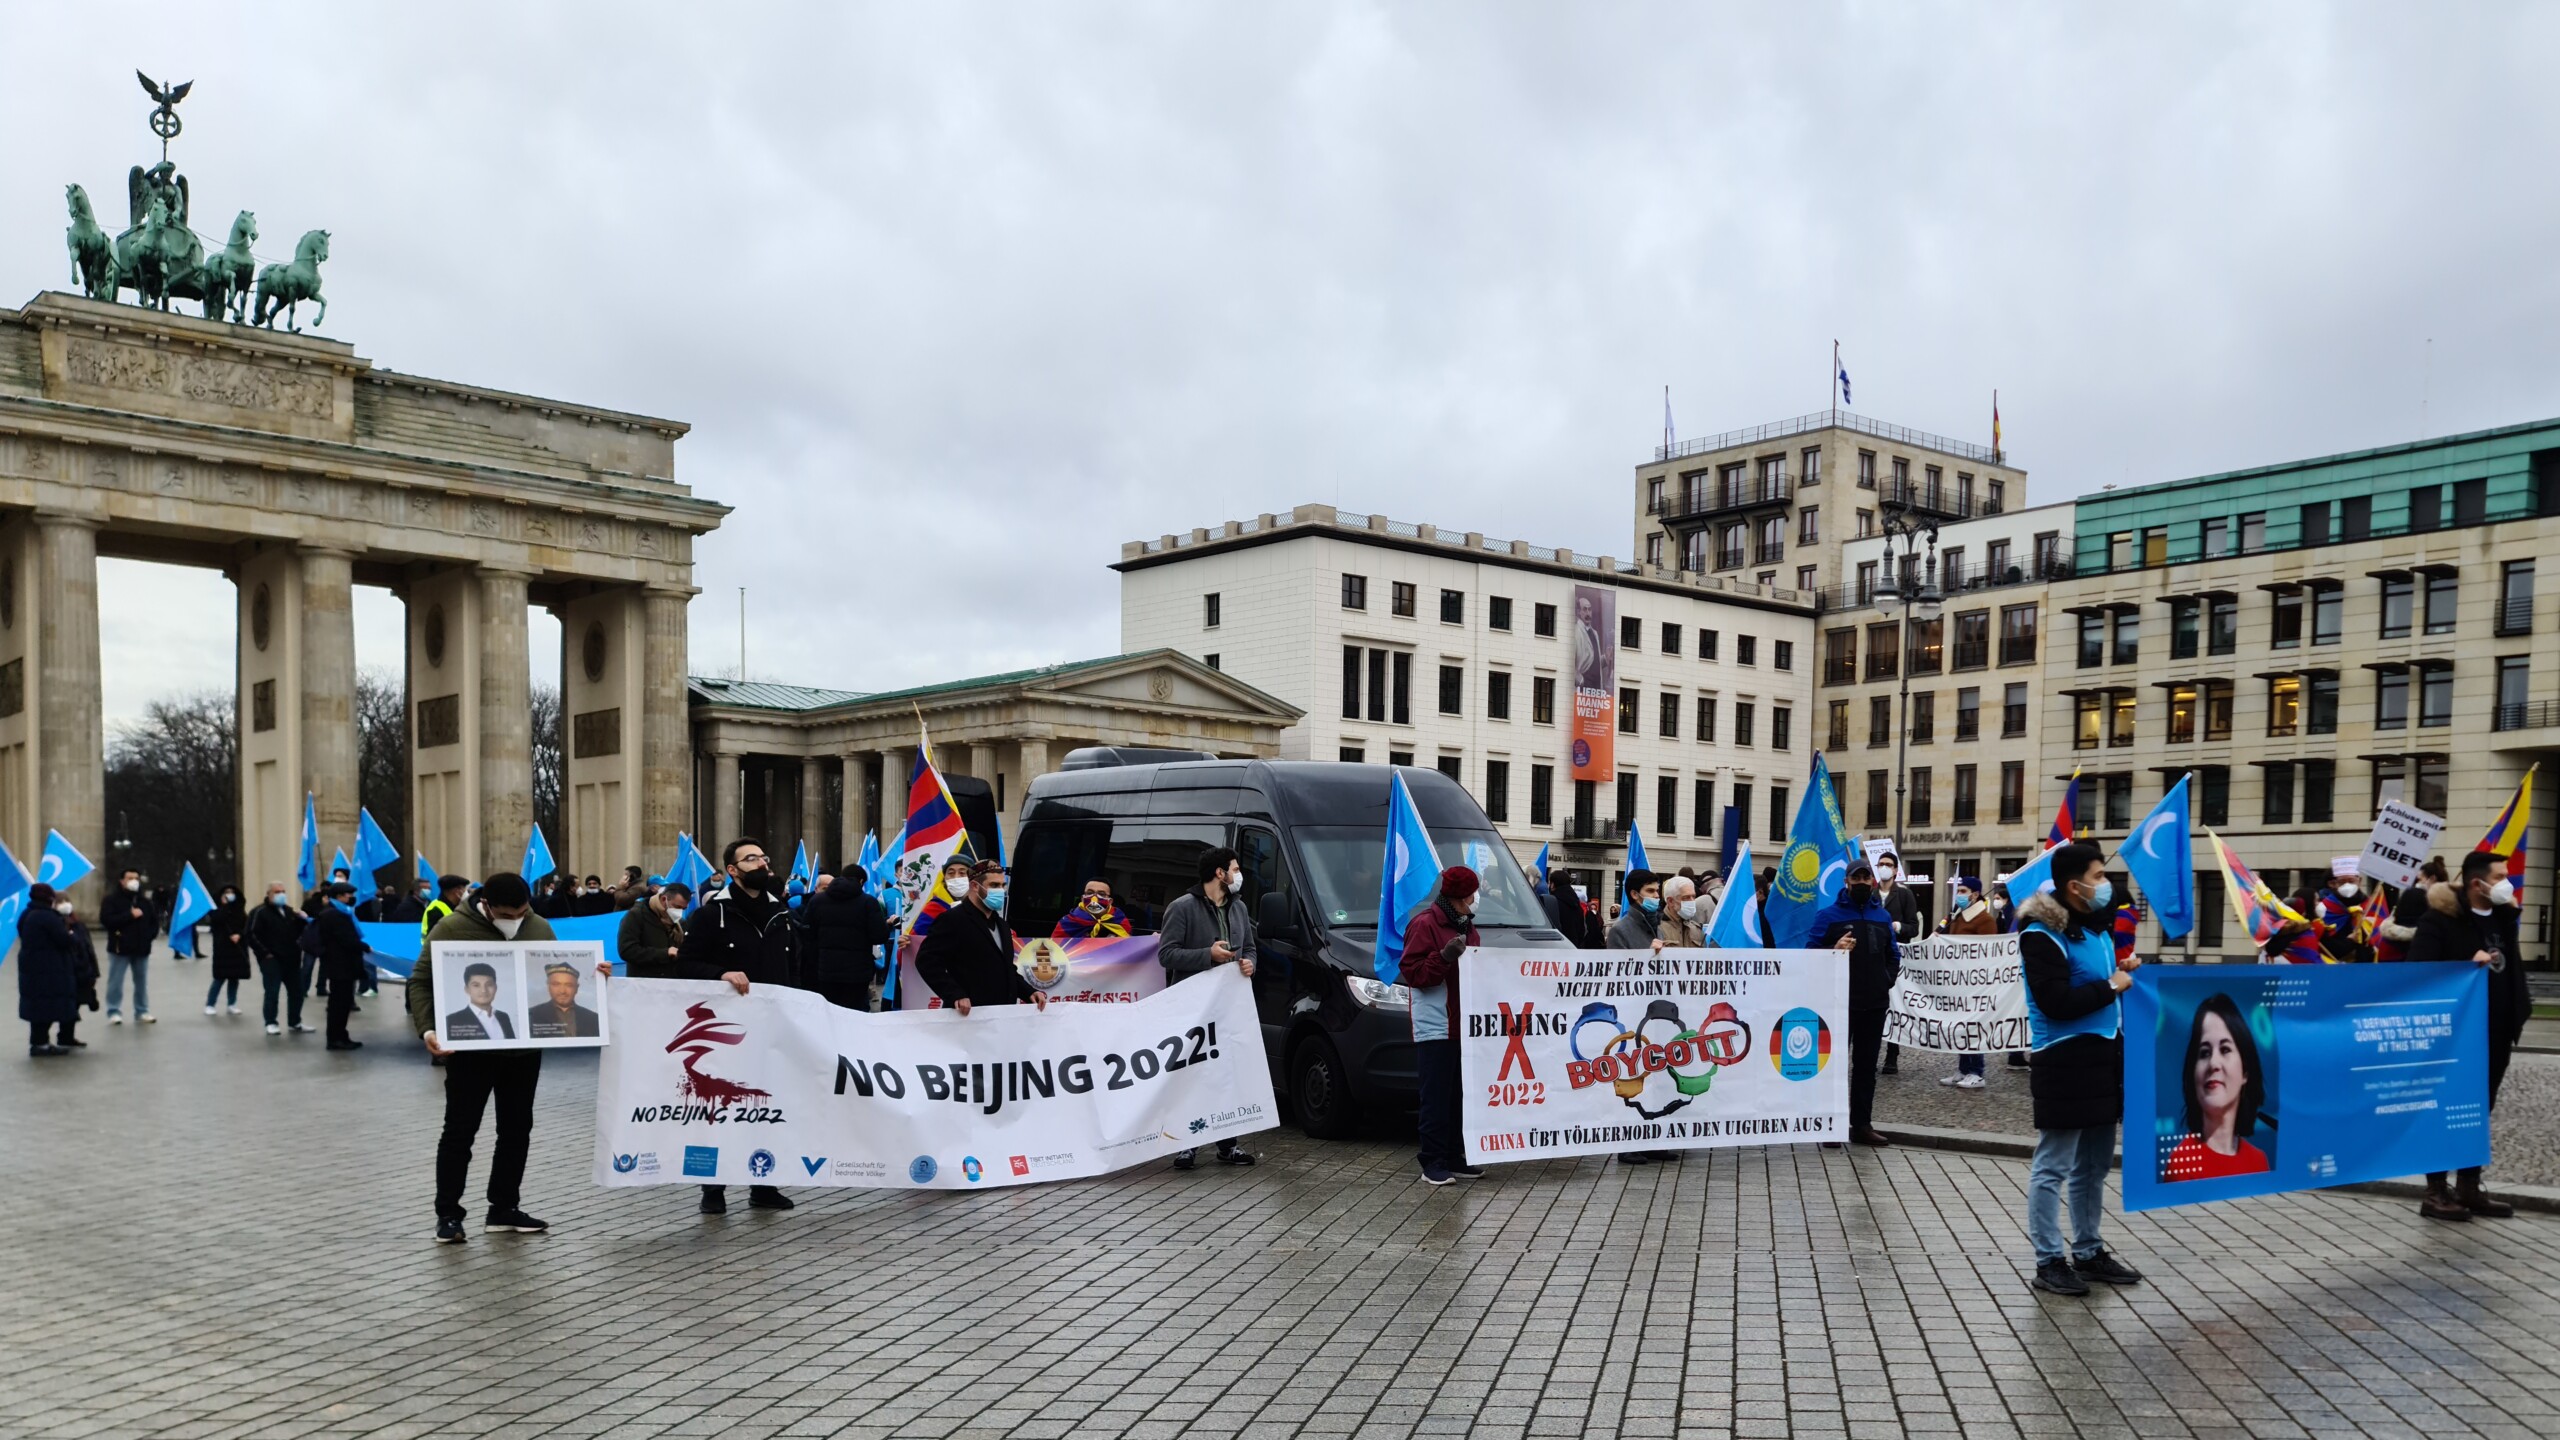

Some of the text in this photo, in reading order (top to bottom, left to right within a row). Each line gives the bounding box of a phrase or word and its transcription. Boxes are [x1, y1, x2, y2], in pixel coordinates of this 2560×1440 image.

[1577, 686, 1611, 699] LIEBER-
[1577, 696, 1610, 709] MANNS
[1577, 706, 1600, 718] WELT
[2384, 804, 2440, 831] Schluss mit
[1909, 833, 1943, 844] PARISER
[1945, 831, 1970, 843] PLATZ
[2382, 817, 2429, 840] FOLTER
[2396, 838, 2406, 847] in
[1548, 854, 1562, 862] Max
[1603, 858, 1620, 866] Haus
[2371, 841, 2422, 868] TIBET
[1907, 874, 1929, 882] mama
[1933, 943, 1988, 960] UIGUREN
[1991, 942, 2003, 958] IN
[1520, 958, 1782, 977] CHINA DARF FÜR SEIN VERBRECHEN
[1555, 981, 1603, 998] NICHT
[1605, 980, 1674, 997] BELOHNT
[1678, 980, 1738, 996] WERDEN
[1903, 990, 1997, 1012] FESTGEHALTEN
[1469, 1012, 1568, 1038] BEIJING
[2362, 1016, 2411, 1029] DEFINITELY
[2441, 1013, 2451, 1024] BE
[1918, 1017, 1951, 1049] DEN
[2354, 1025, 2452, 1042] GOING TO THE OLYMPICS
[2377, 1042, 2389, 1053] AT
[2390, 1040, 2409, 1052] THIS
[834, 1022, 1220, 1115] NO BEIJING 2022!
[1566, 1030, 1740, 1090] BOYCOTT
[1487, 1082, 1546, 1107] 2022
[631, 1105, 787, 1126] NO BEIJING 2022
[1210, 1104, 1262, 1124] Falun Dafa
[1480, 1132, 1525, 1152] CHINA
[1529, 1128, 1560, 1148] ÜBT
[1564, 1123, 1662, 1145] VÖLKERMORD
[1666, 1122, 1687, 1139] AN
[1692, 1121, 1721, 1138] DEN
[1725, 1118, 1789, 1136] UIGUREN
[1793, 1117, 1823, 1132] AUS
[836, 1160, 886, 1169] Gesellschaft für
[1045, 1153, 1073, 1161] INITIATIVE
[638, 1164, 661, 1172] CONGRESS
[835, 1169, 865, 1177] bedrohte
